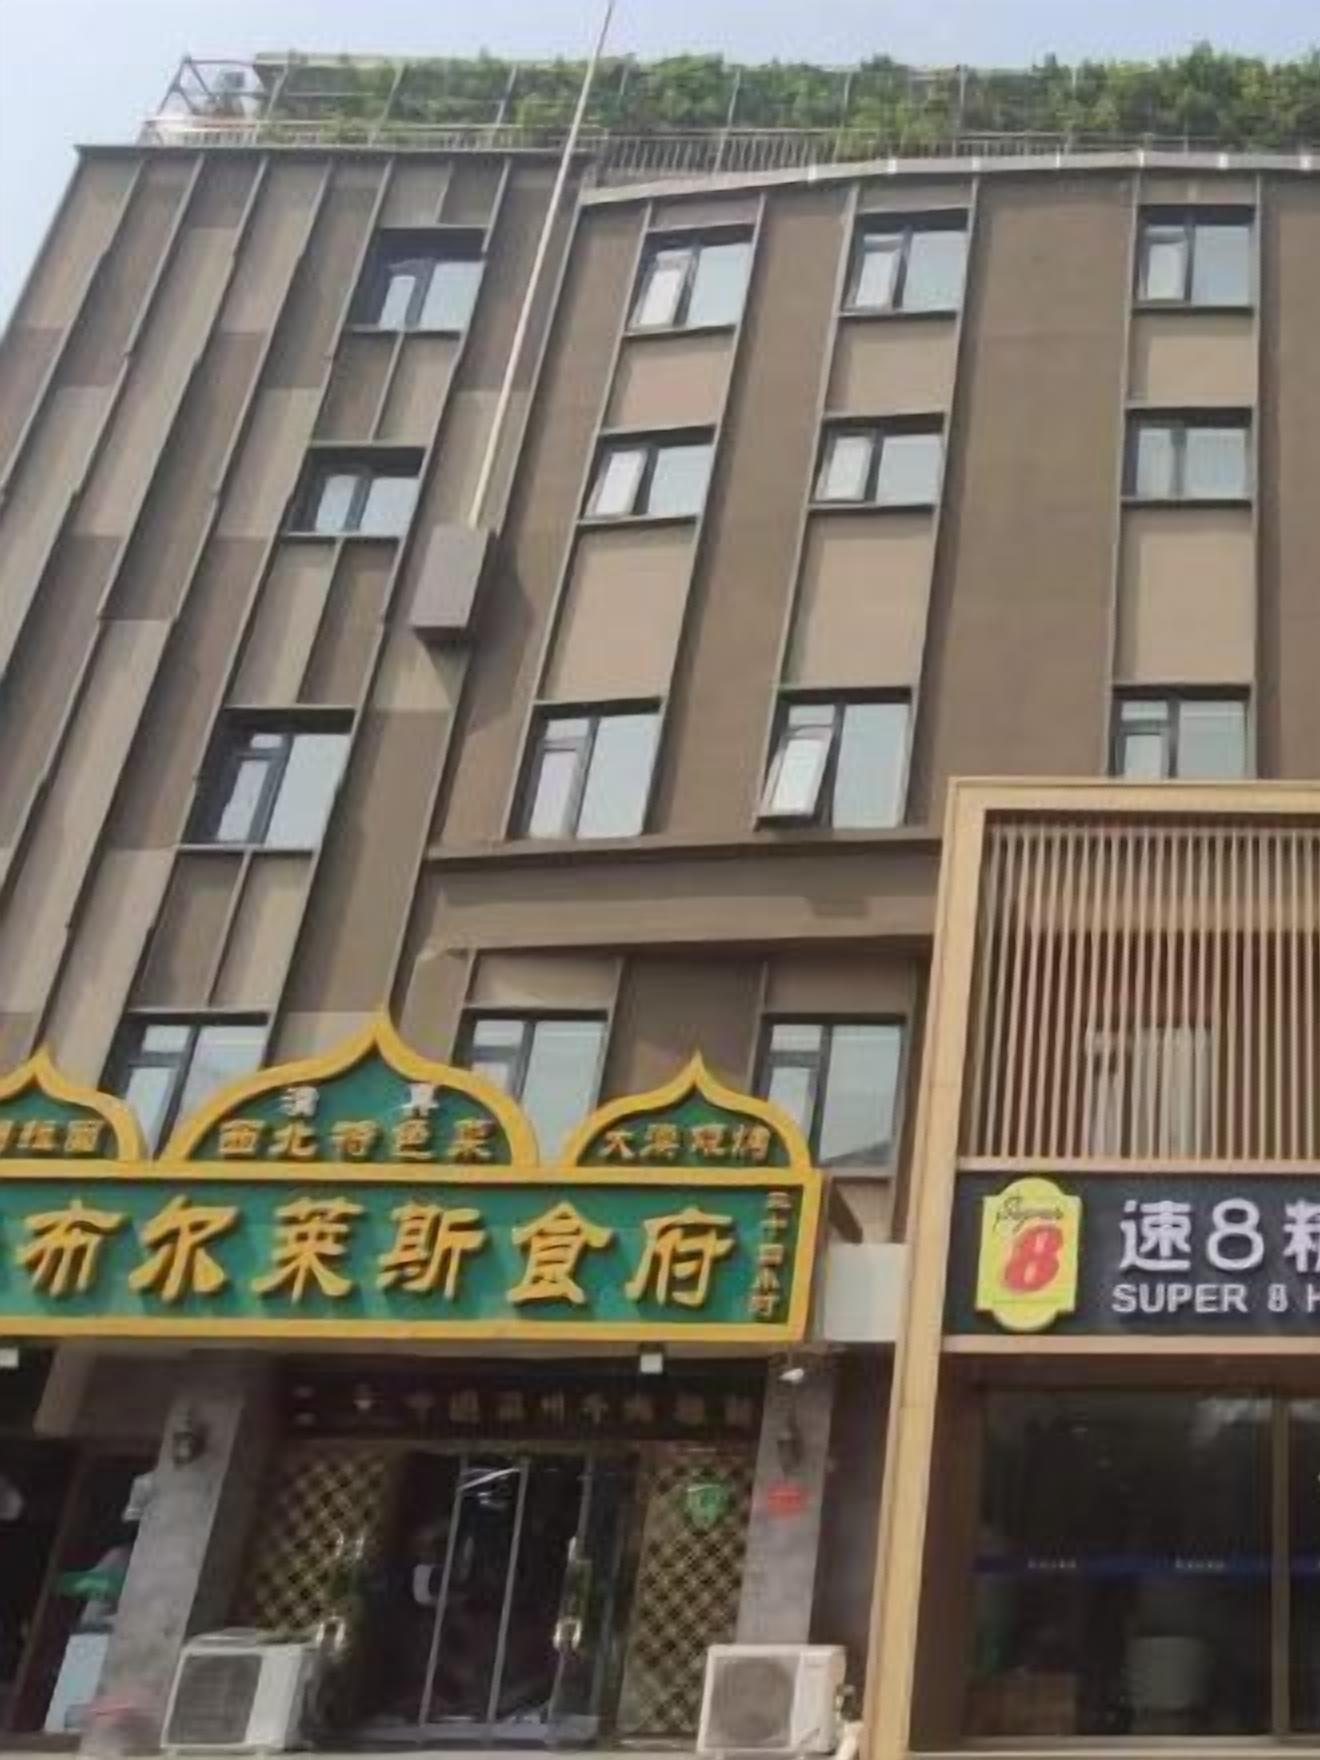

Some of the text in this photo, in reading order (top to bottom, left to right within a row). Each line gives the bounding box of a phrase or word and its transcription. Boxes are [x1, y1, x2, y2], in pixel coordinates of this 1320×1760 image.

[16, 1194, 736, 1306] 布尔莱斯食府
[1004, 1224, 1064, 1293] 8
[1111, 1283, 1249, 1313] SUPER
[1267, 1283, 1289, 1313] 8
